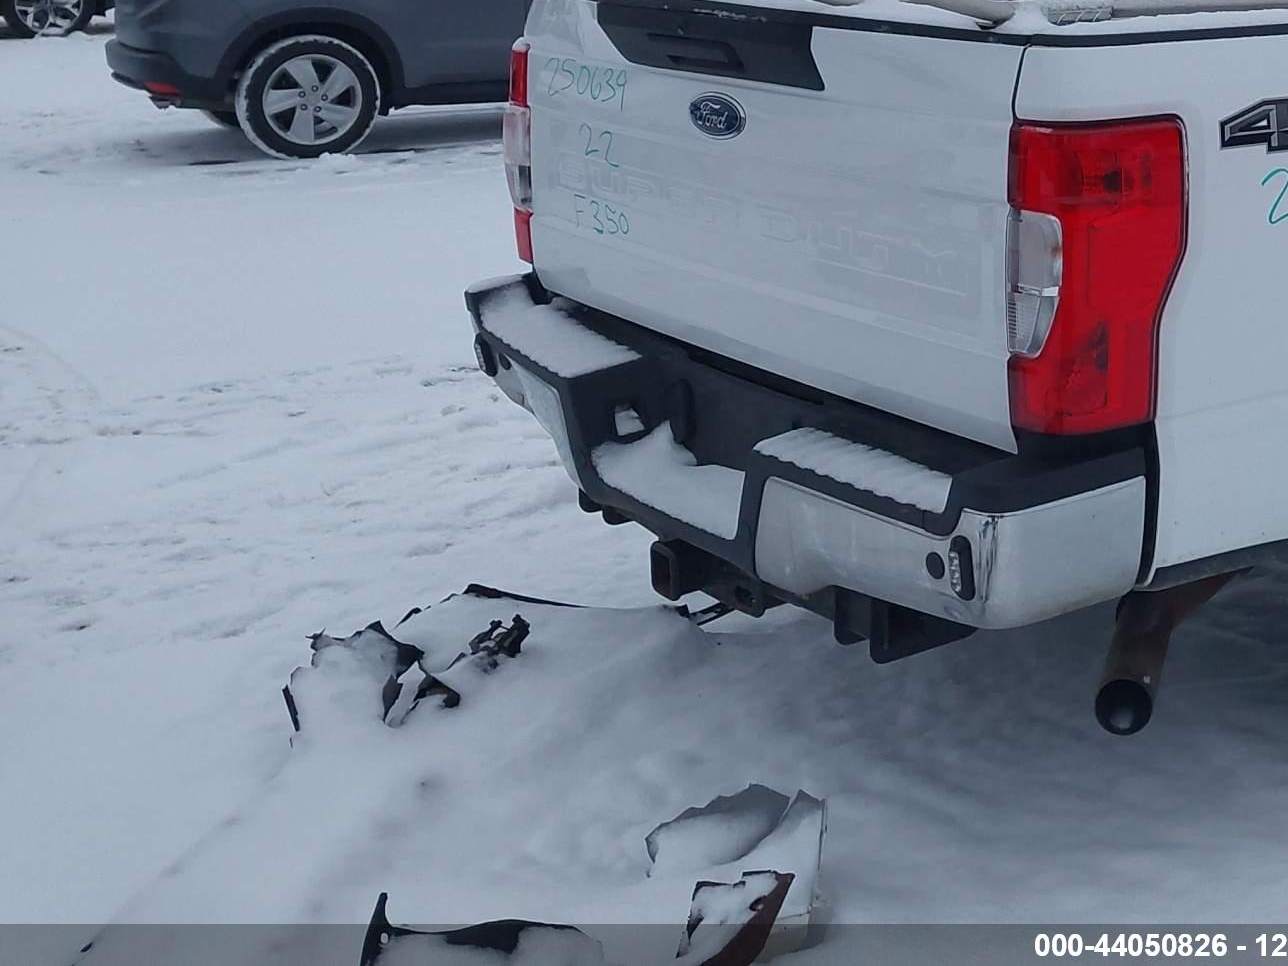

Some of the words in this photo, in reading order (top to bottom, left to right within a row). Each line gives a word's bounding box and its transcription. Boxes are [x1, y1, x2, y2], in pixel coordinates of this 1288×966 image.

[544, 56, 629, 112] 250639
[697, 101, 729, 129] Ford
[579, 123, 620, 168] 22
[573, 193, 631, 235] F350
